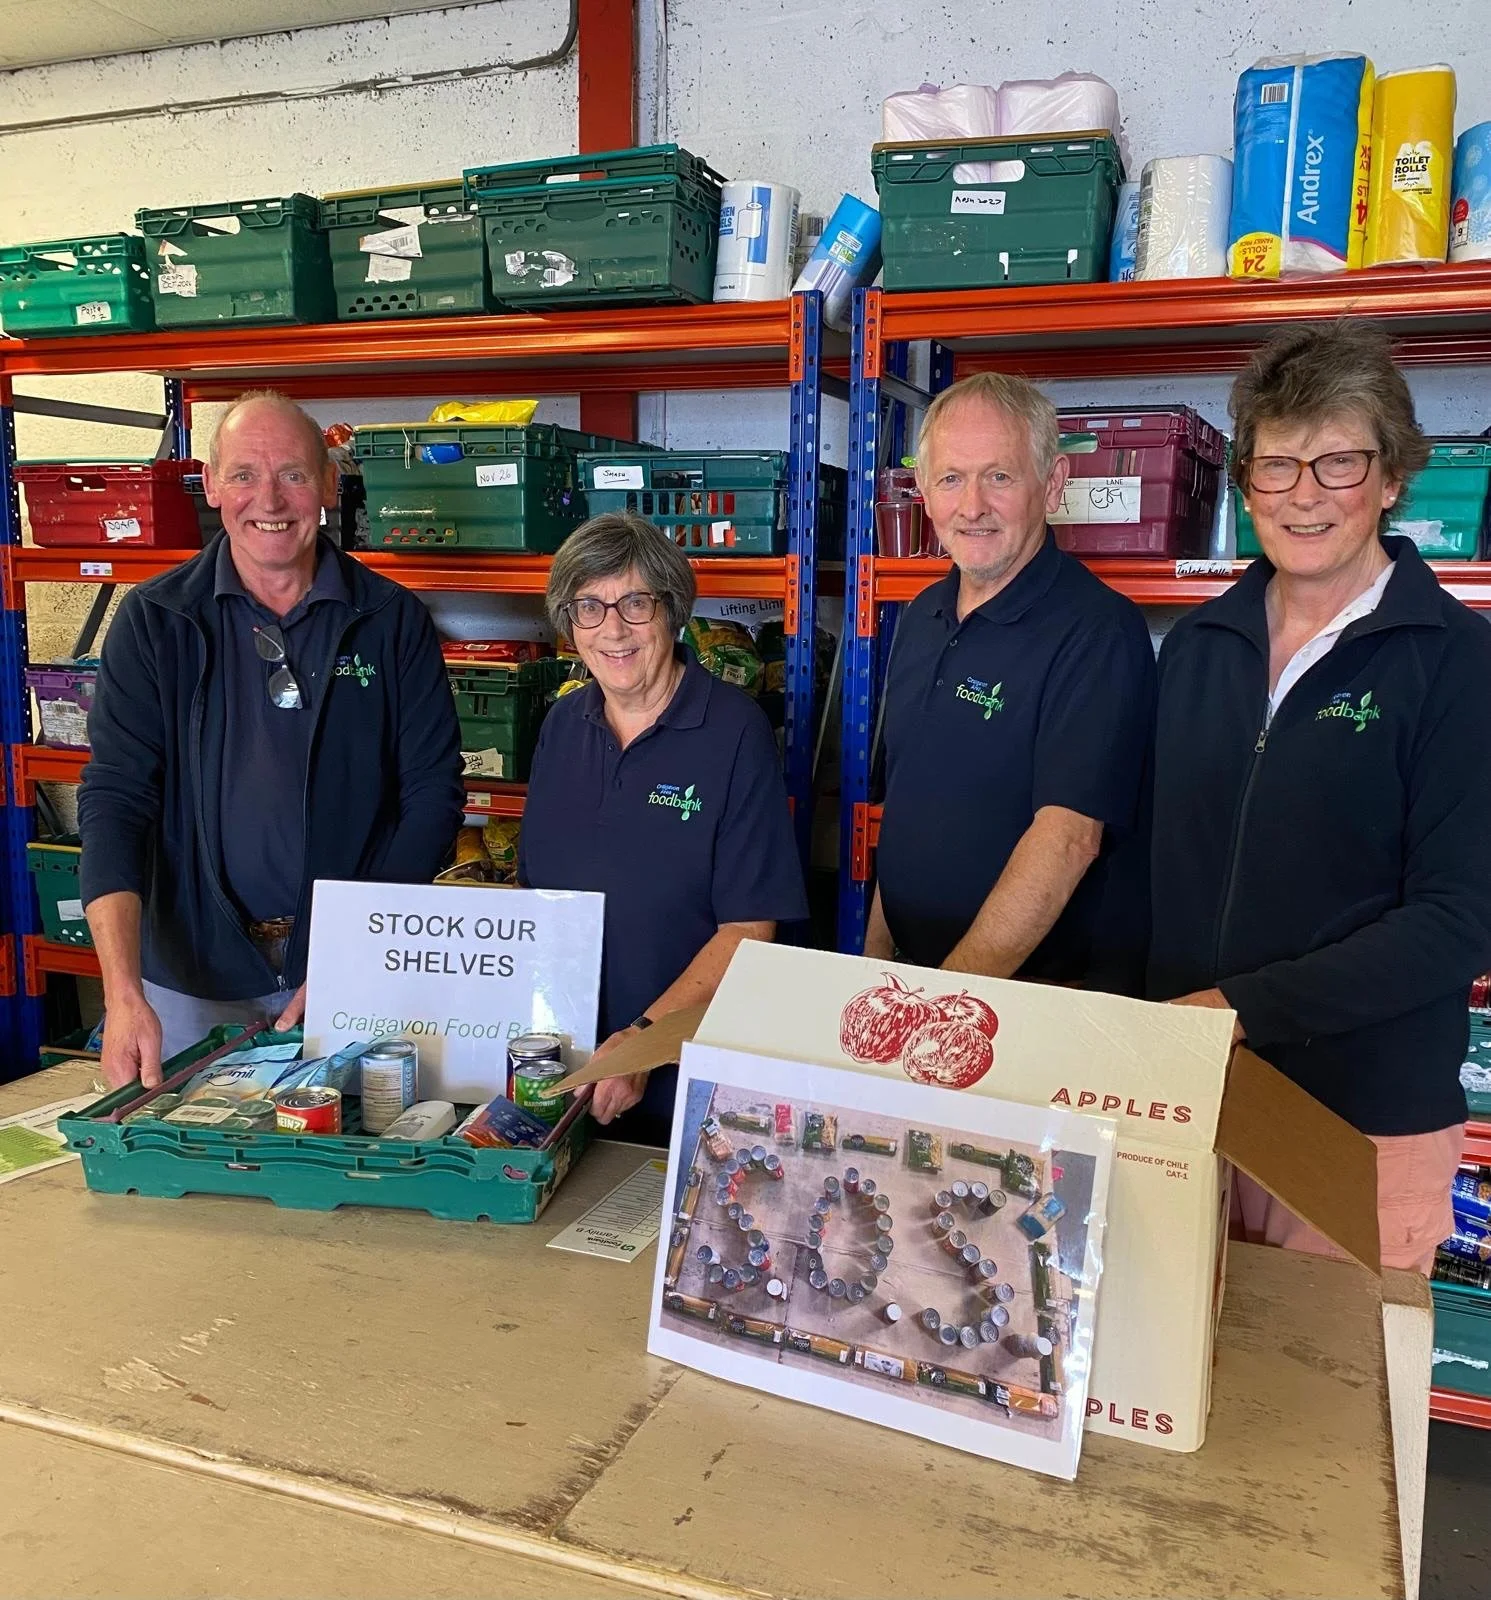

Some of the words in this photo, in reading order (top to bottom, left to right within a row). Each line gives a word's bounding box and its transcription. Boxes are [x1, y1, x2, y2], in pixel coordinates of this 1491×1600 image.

[1394, 164, 1428, 174] ROLLS
[1395, 156, 1431, 166] TOILET
[1297, 135, 1325, 225] Andrex
[1243, 255, 1266, 273] 24
[720, 603, 757, 617] Lifting
[955, 684, 1006, 713] foodbank
[647, 791, 702, 812] foodbank
[368, 912, 465, 939] STOCK
[474, 917, 537, 942] OUR
[384, 948, 514, 978] SHELVES
[332, 1011, 438, 1037] Craigavon
[444, 1018, 501, 1039] Food
[1050, 1088, 1192, 1123] APPLES
[1116, 1151, 1153, 1164] PRODUCE
[1154, 1156, 1165, 1166] OF
[1166, 1160, 1189, 1170] CHILE
[1166, 1170, 1189, 1180] CAT-1
[584, 1228, 620, 1240] Family
[1085, 1397, 1174, 1435] PLES
